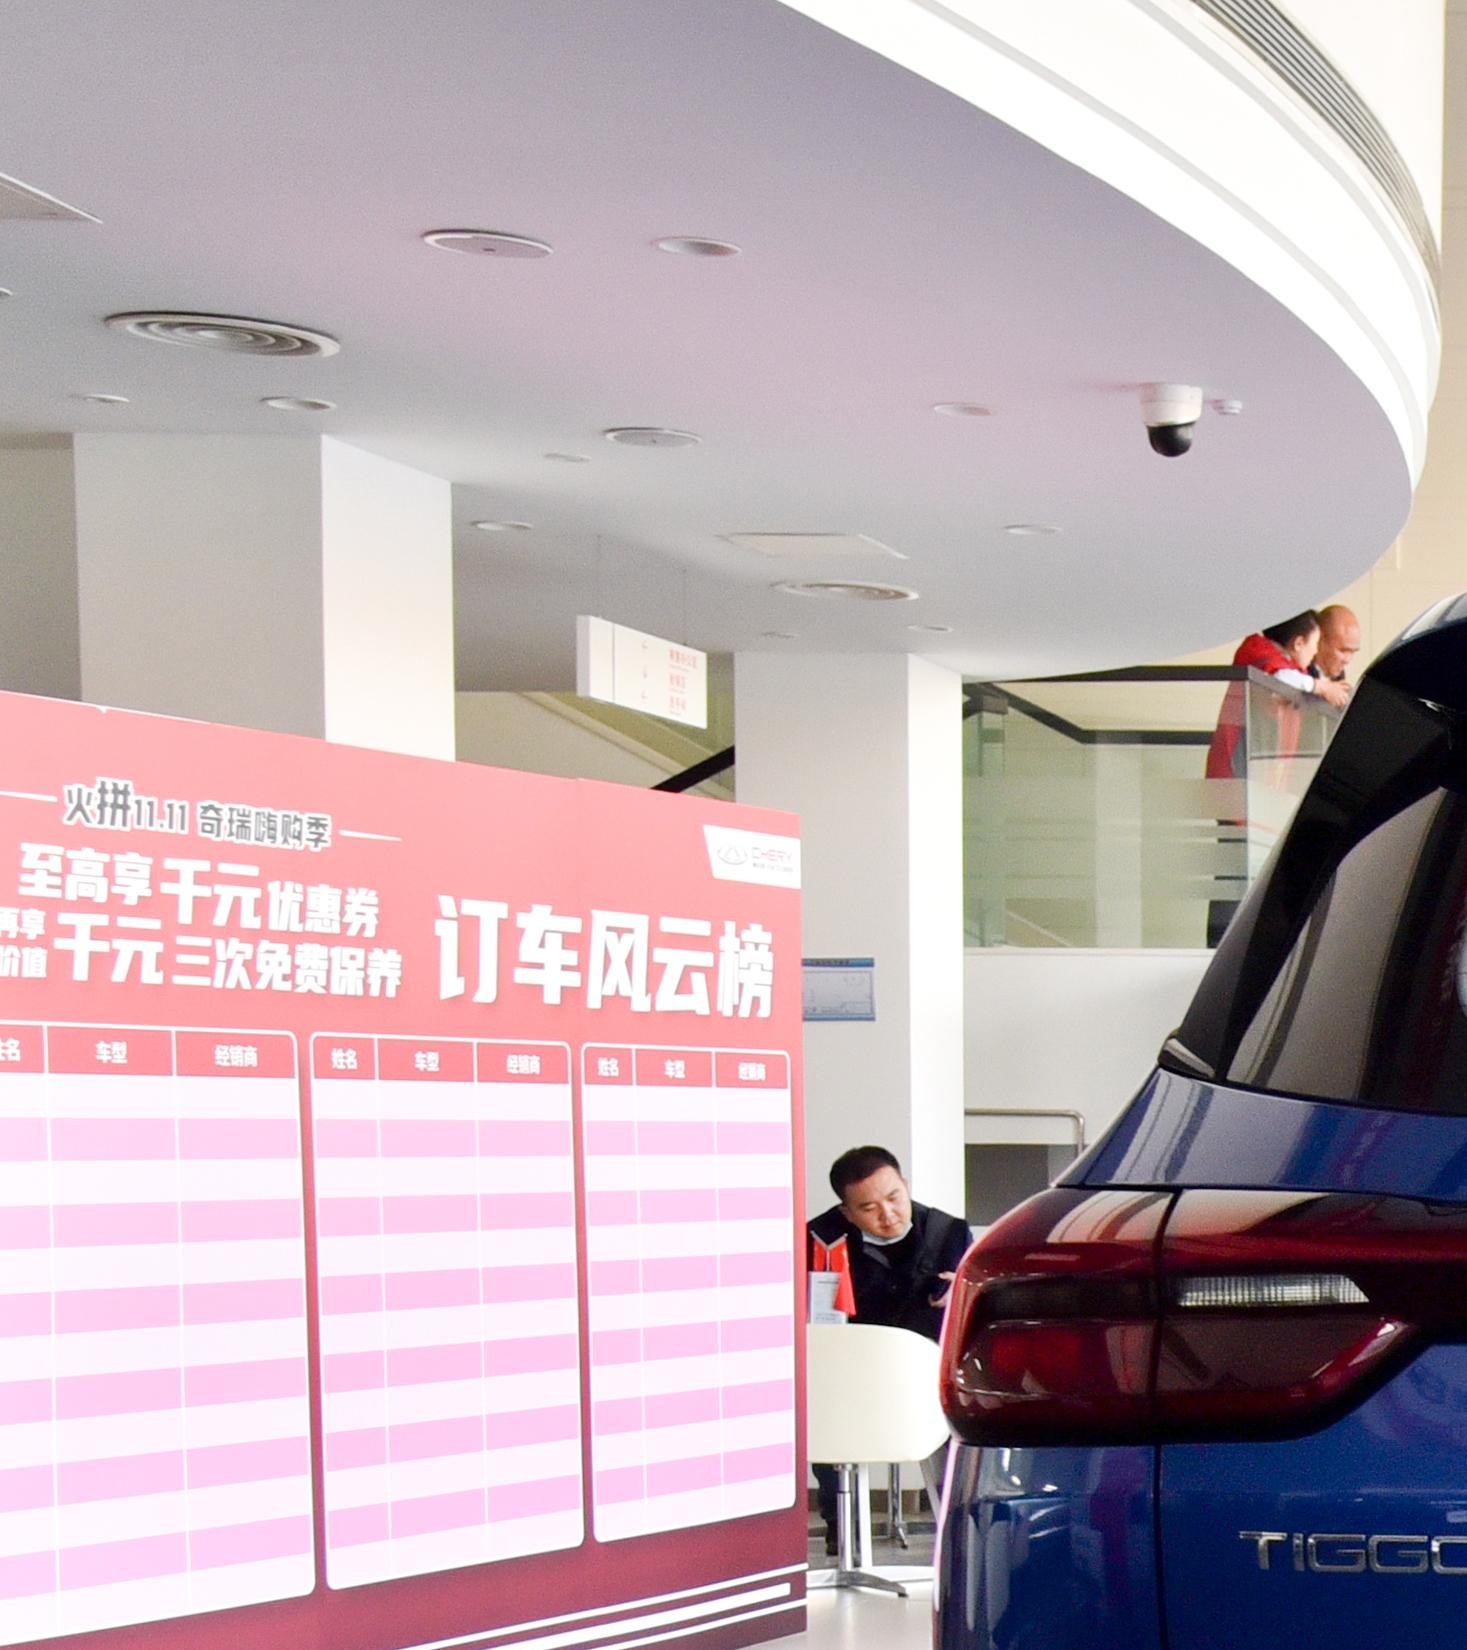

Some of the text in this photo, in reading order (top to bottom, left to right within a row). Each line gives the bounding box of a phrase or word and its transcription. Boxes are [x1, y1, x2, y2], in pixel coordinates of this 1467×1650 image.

[198, 802, 331, 850] 奇瑞嗨购季
[434, 894, 774, 1019] 订车风云榜
[96, 1041, 128, 1064] 车型
[214, 1044, 258, 1068] 经销商
[331, 1048, 358, 1070] 姓名
[414, 1051, 440, 1072] 车型
